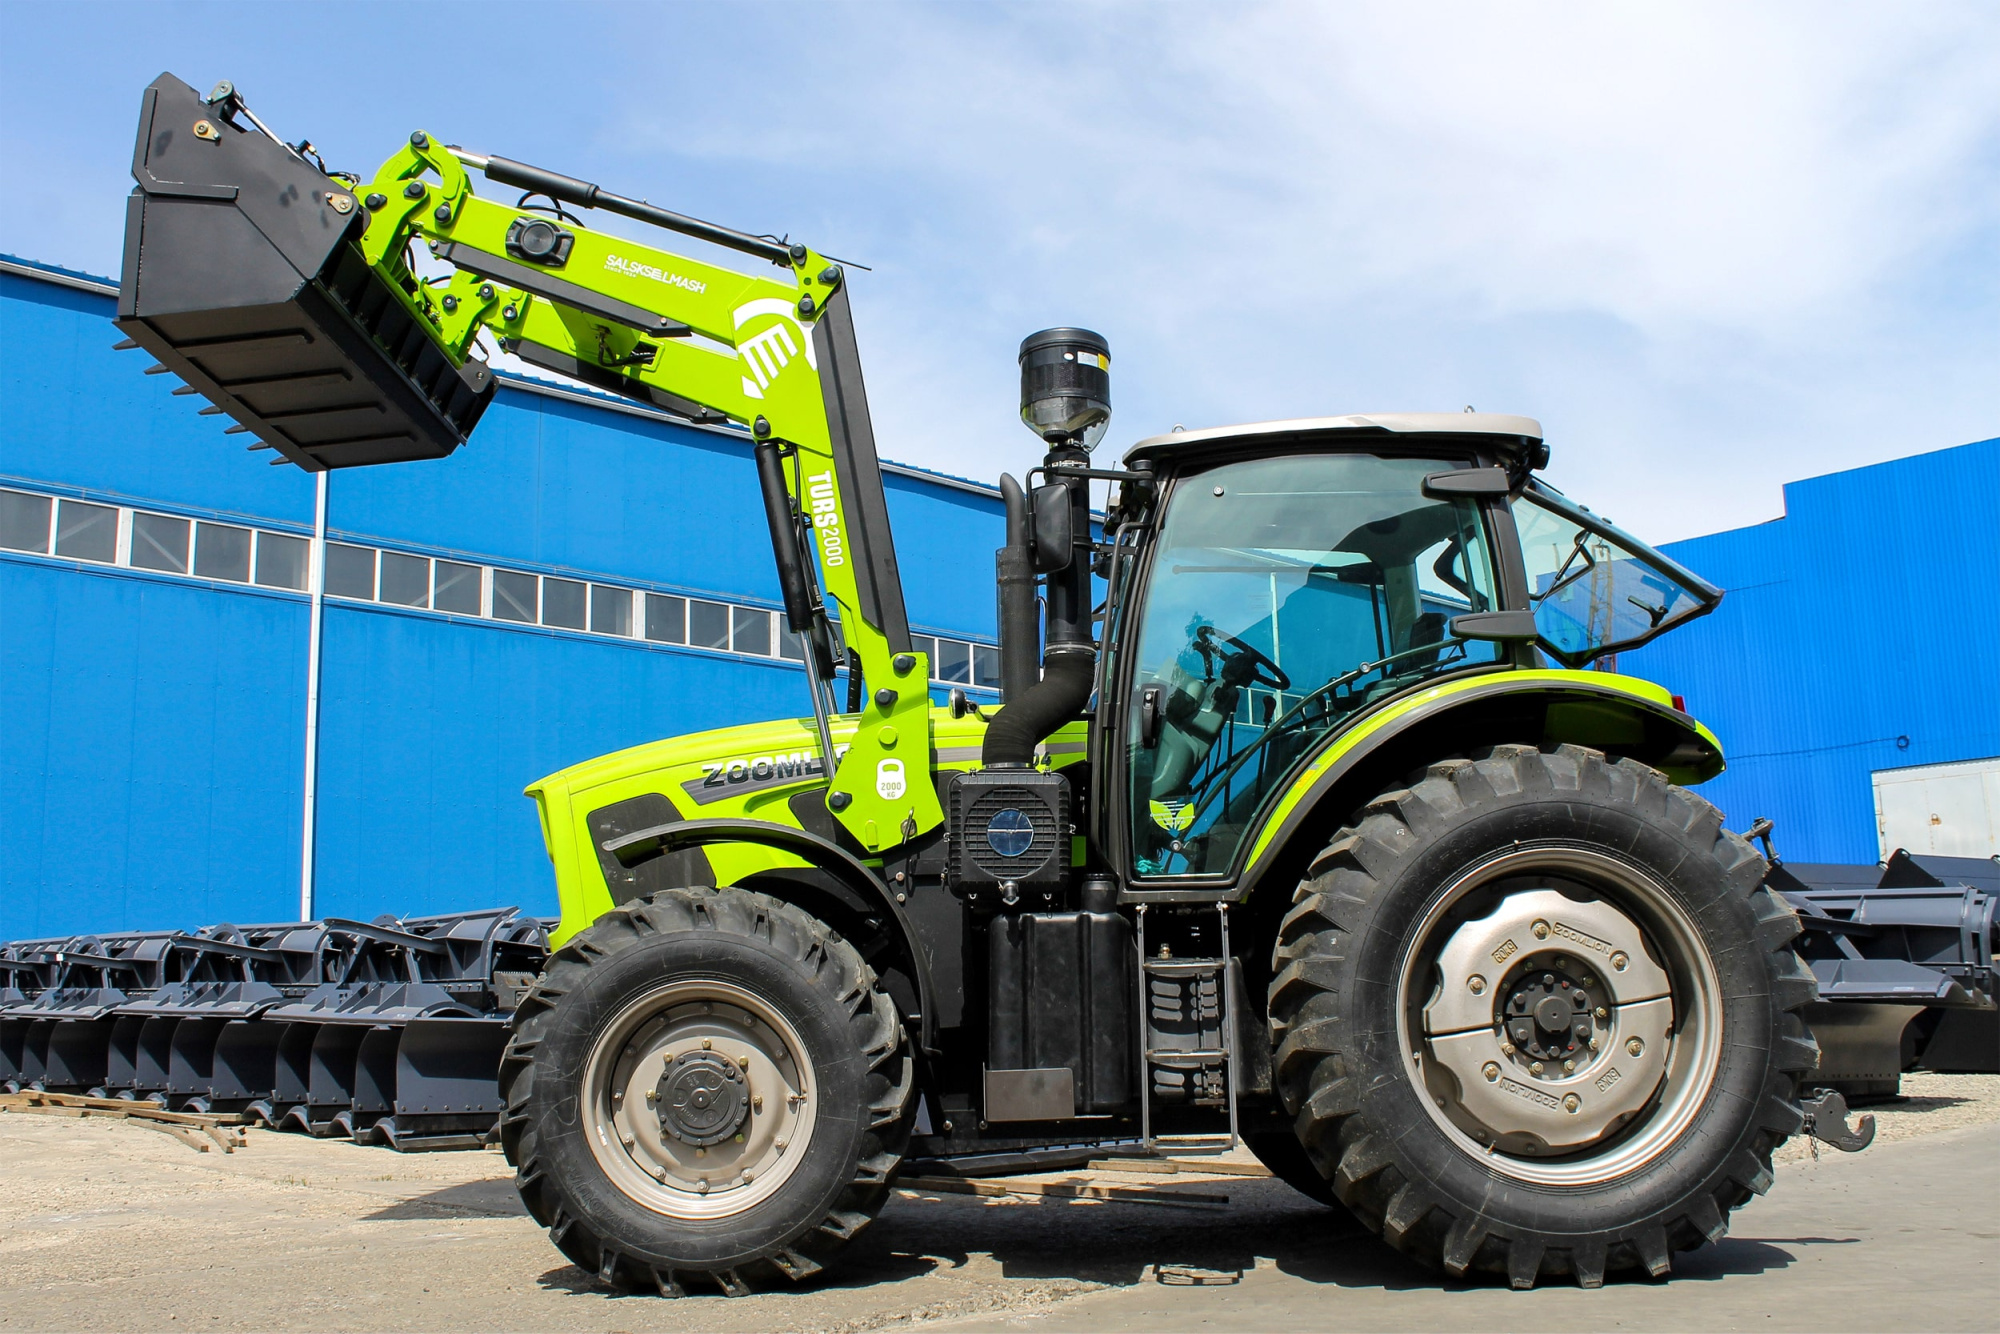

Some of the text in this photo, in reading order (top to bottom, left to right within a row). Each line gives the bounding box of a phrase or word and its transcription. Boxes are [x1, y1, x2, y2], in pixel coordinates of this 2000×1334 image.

[881, 782, 902, 791] 2000
[1554, 923, 1612, 955] ZOOMLION
[1500, 1080, 1558, 1110] ZOOMLION
